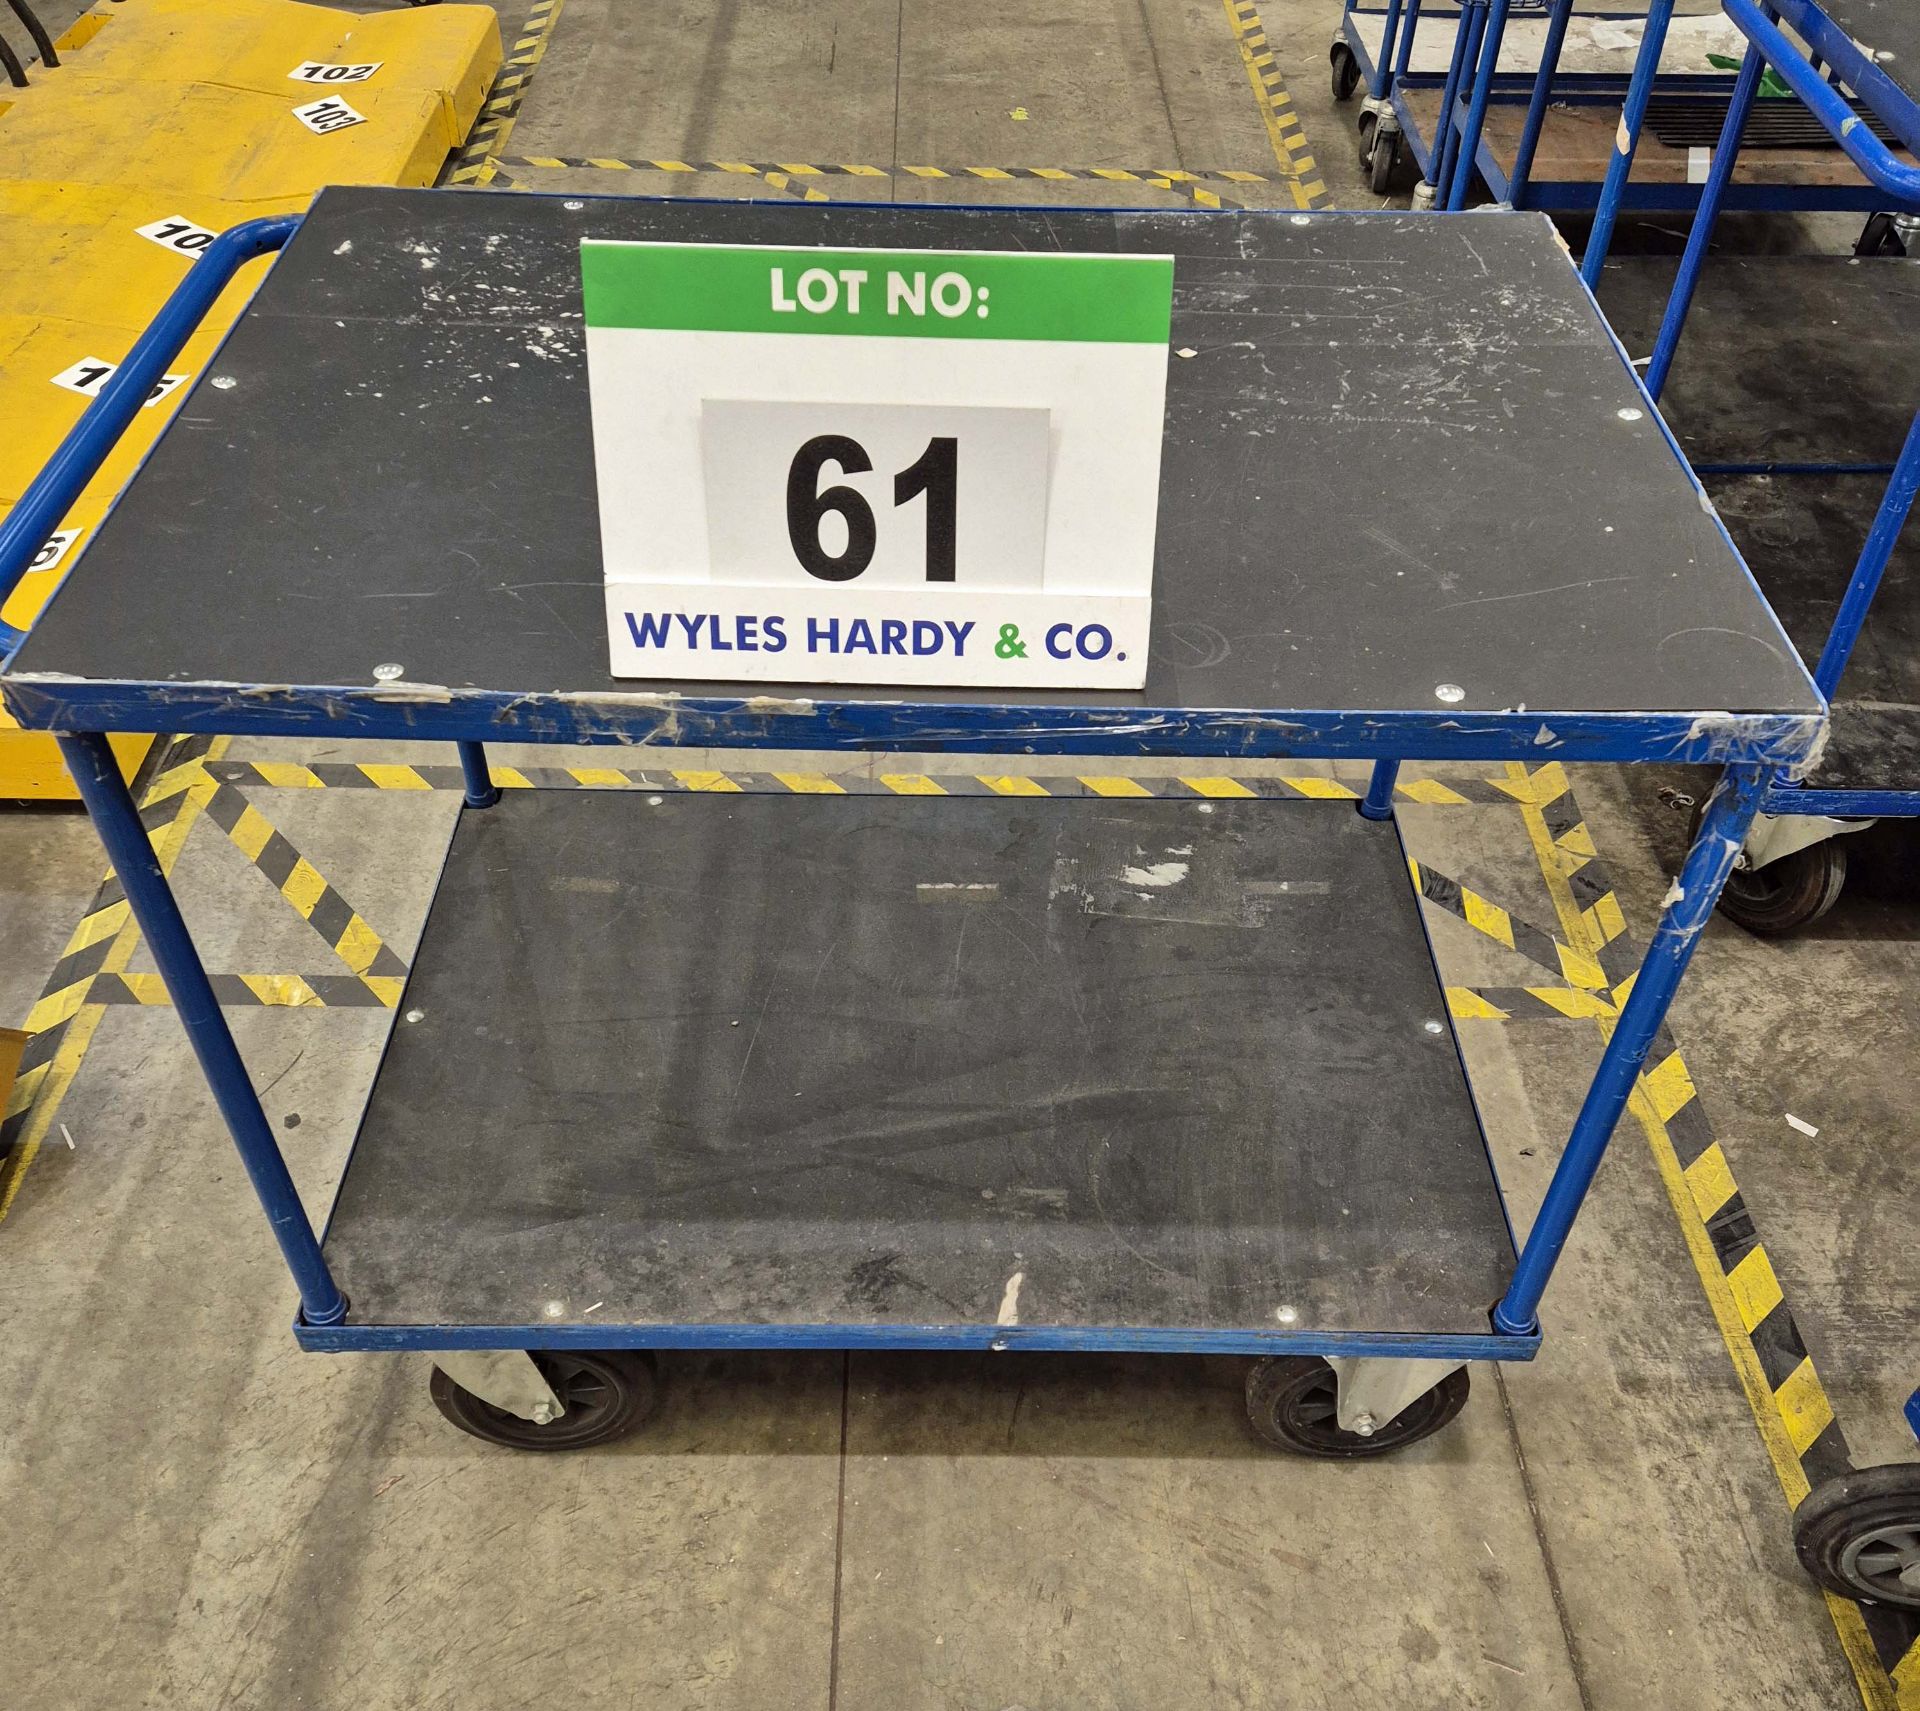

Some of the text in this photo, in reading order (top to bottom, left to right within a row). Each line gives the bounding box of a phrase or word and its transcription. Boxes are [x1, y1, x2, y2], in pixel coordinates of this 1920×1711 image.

[303, 65, 373, 80] 102
[303, 102, 358, 131] 103
[153, 223, 215, 253] 10
[770, 267, 990, 319] LOT NO:
[785, 434, 958, 582] 61
[624, 612, 1128, 662] WYLES HARDY & CO.
